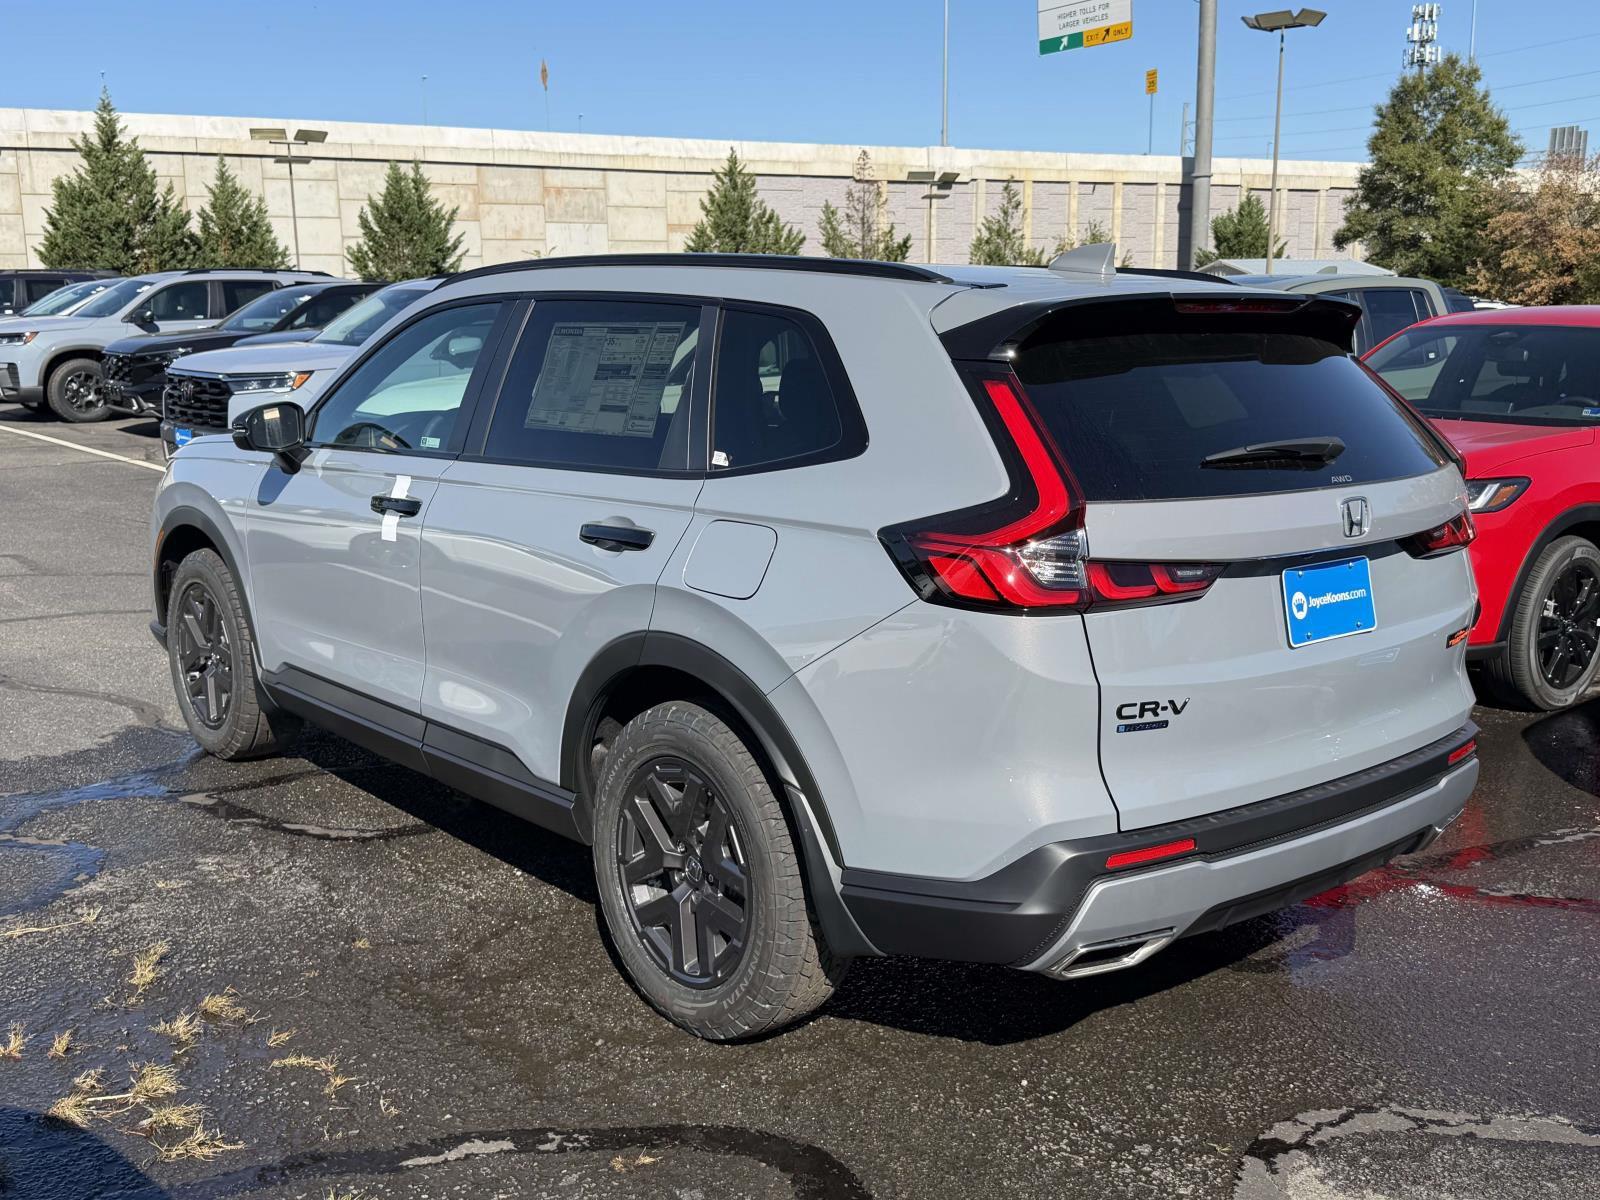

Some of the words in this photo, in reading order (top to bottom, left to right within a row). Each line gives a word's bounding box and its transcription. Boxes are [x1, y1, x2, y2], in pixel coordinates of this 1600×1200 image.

[1057, 10, 1077, 20] HIGHER
[1079, 5, 1097, 15] TOLLS
[1098, 2, 1110, 11] FOR
[1058, 19, 1080, 30] LARGER
[1082, 13, 1109, 25] VEHICLES
[1086, 33, 1099, 42] EXIT
[1112, 27, 1128, 36] ONLY
[1331, 474, 1353, 484] AWD
[1308, 588, 1367, 609] JoyceKoons.com
[1116, 697, 1191, 720] CR-V
